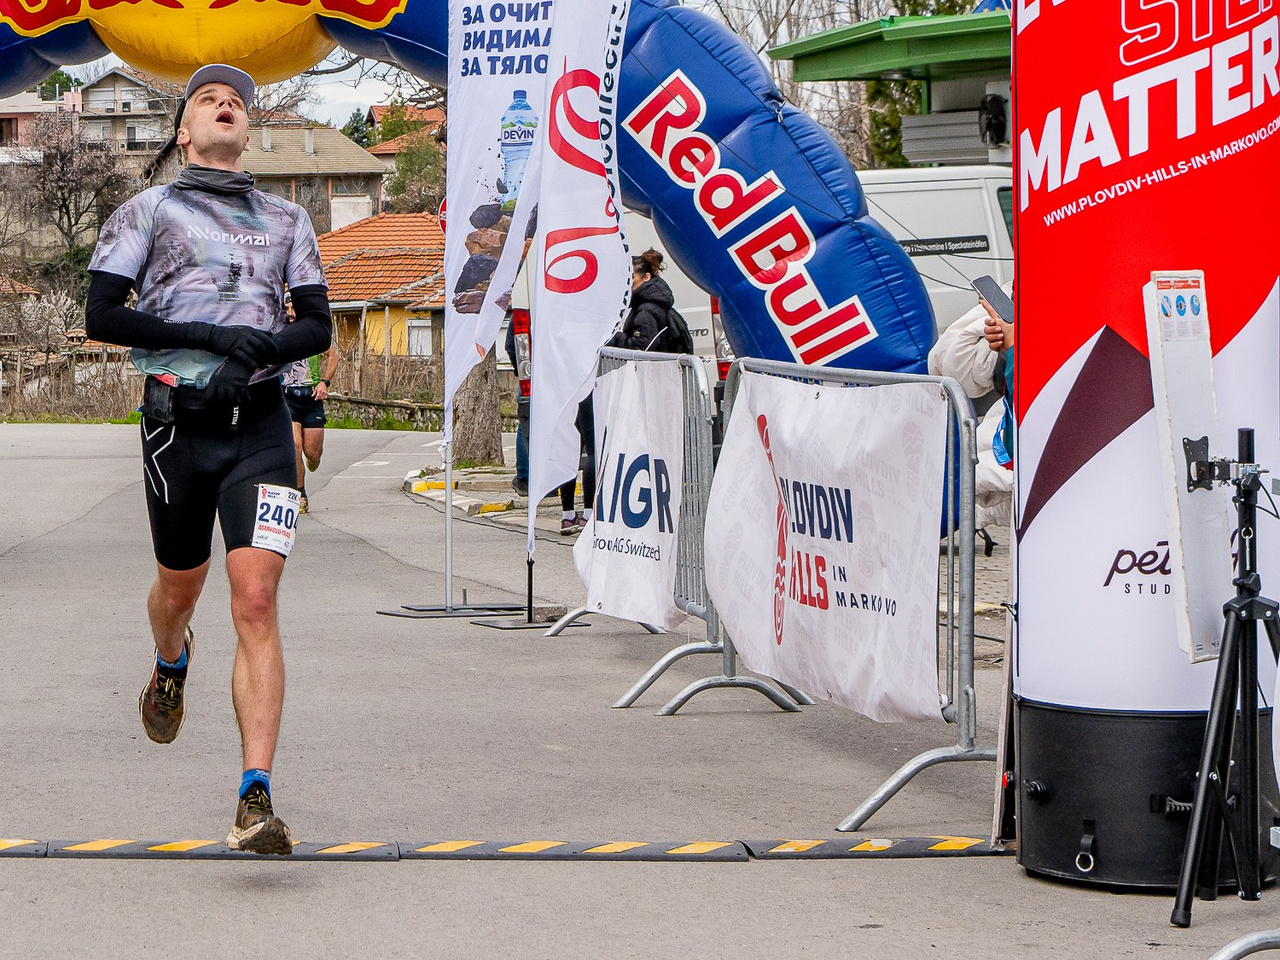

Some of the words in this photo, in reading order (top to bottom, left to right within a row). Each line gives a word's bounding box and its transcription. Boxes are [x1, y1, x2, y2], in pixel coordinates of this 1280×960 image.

[462, 4, 485, 26] ЗА
[489, 0, 553, 23] ОЧИТ
[461, 56, 482, 77] ЗА
[487, 53, 549, 75] ТЯЛО
[1020, 15, 1280, 213] MATTER
[503, 129, 535, 140] DEVIN
[627, 75, 780, 232] Red
[733, 212, 873, 366] Bull
[832, 564, 847, 583] IN
[1124, 583, 1171, 595] STUD
[835, 590, 897, 616] MARKOVO
